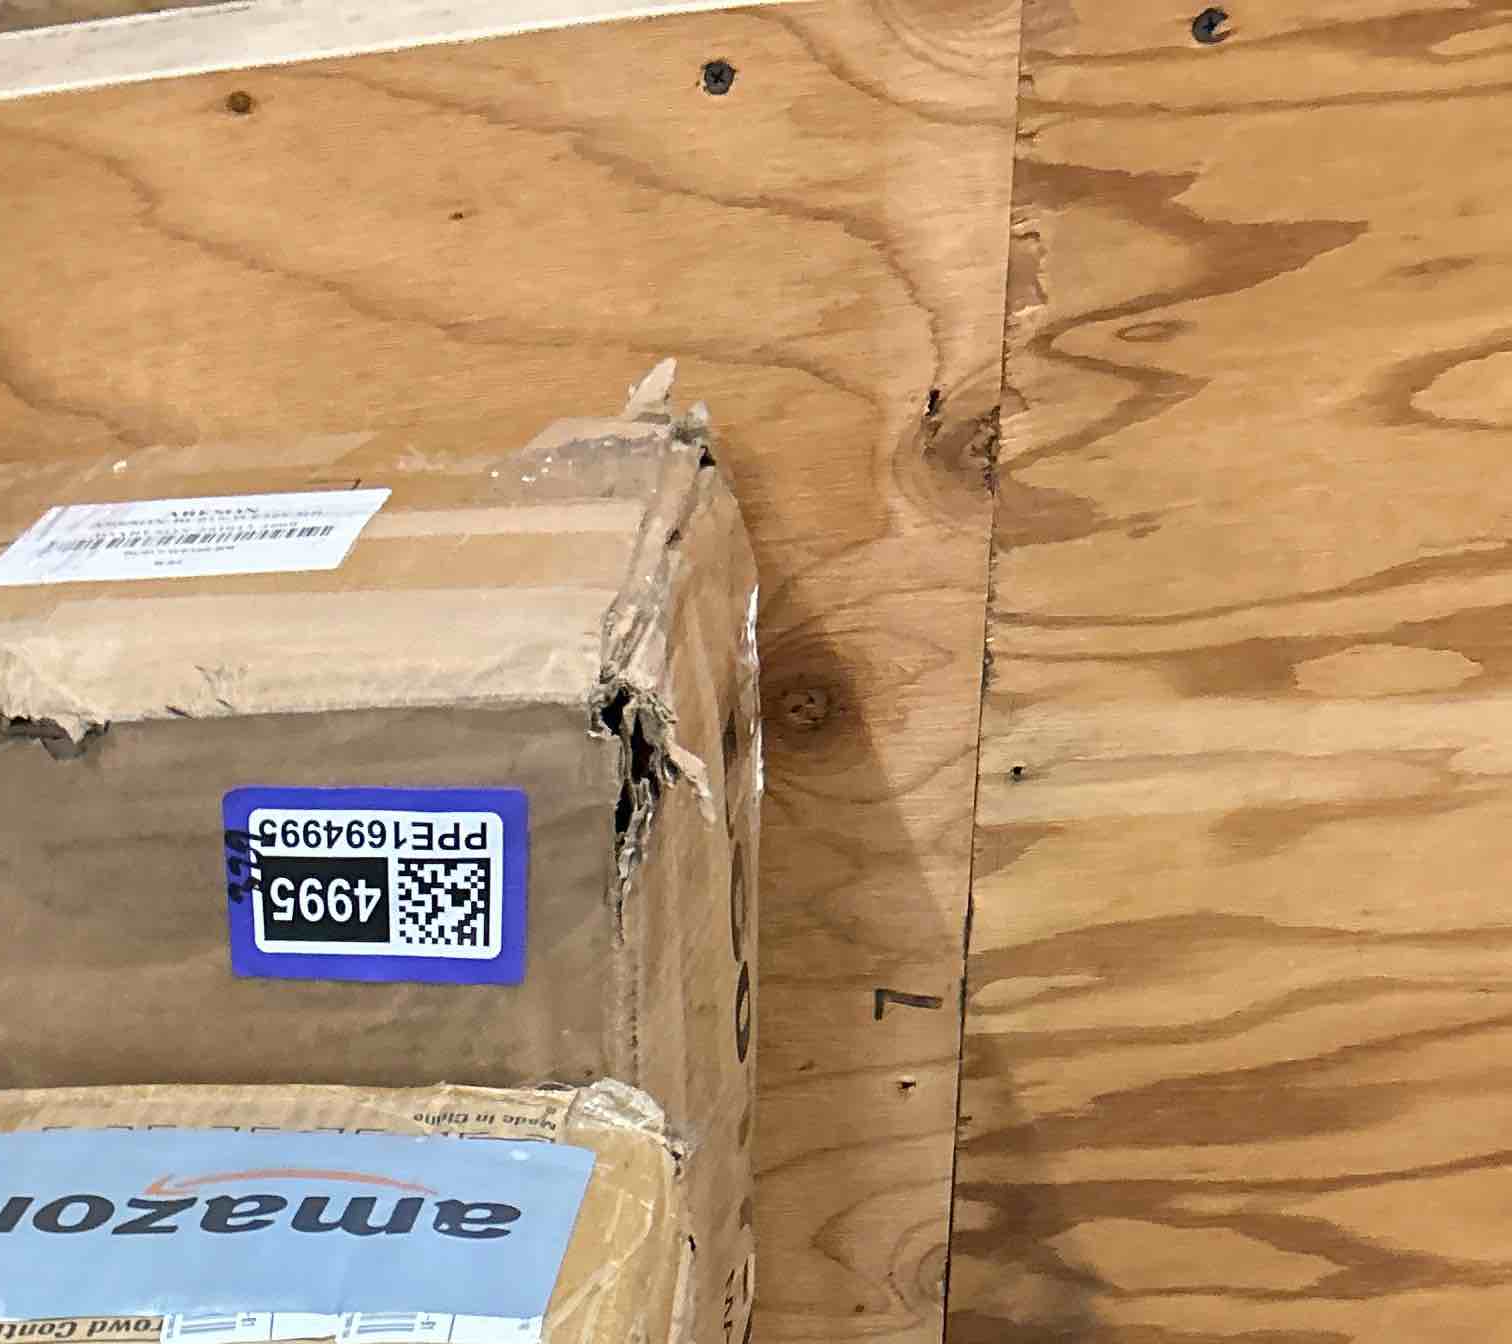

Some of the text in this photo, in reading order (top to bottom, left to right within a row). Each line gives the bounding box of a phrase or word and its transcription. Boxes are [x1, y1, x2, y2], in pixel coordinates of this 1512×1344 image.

[258, 818, 488, 851] PPE1694995
[269, 877, 382, 922] 4995
[87, 1316, 165, 1334] rowd
